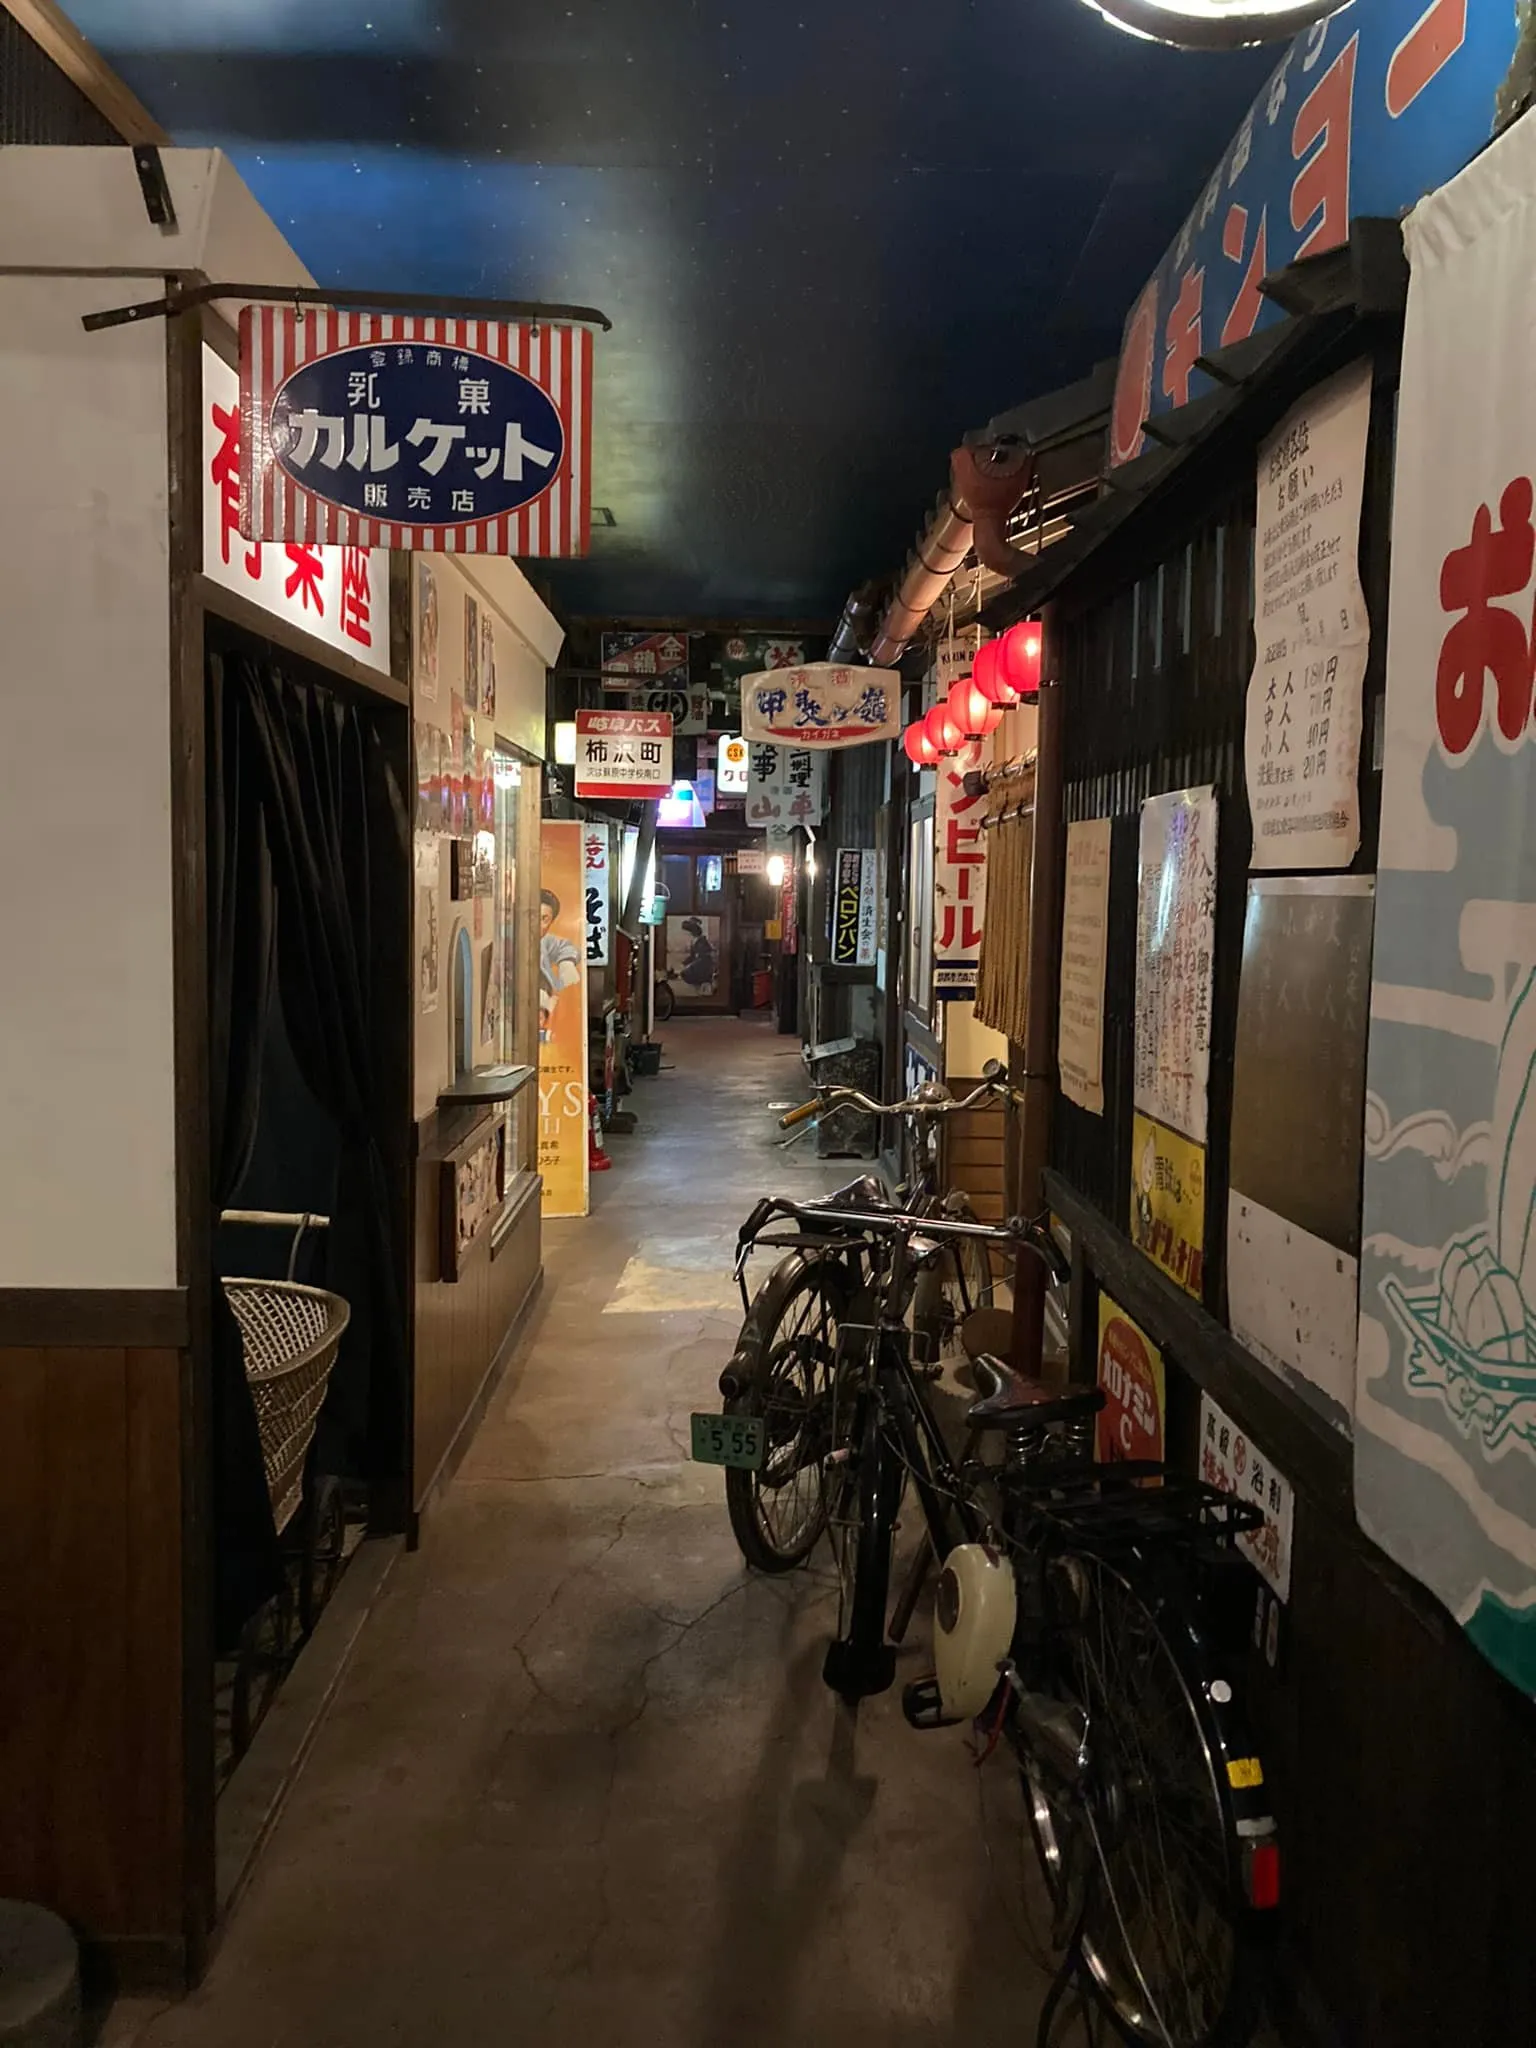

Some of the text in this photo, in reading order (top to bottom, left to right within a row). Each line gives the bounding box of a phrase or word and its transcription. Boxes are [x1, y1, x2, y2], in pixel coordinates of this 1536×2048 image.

[287, 408, 555, 482] カルケット
[364, 483, 476, 513] 販売店
[587, 717, 661, 733] 岐阜バス
